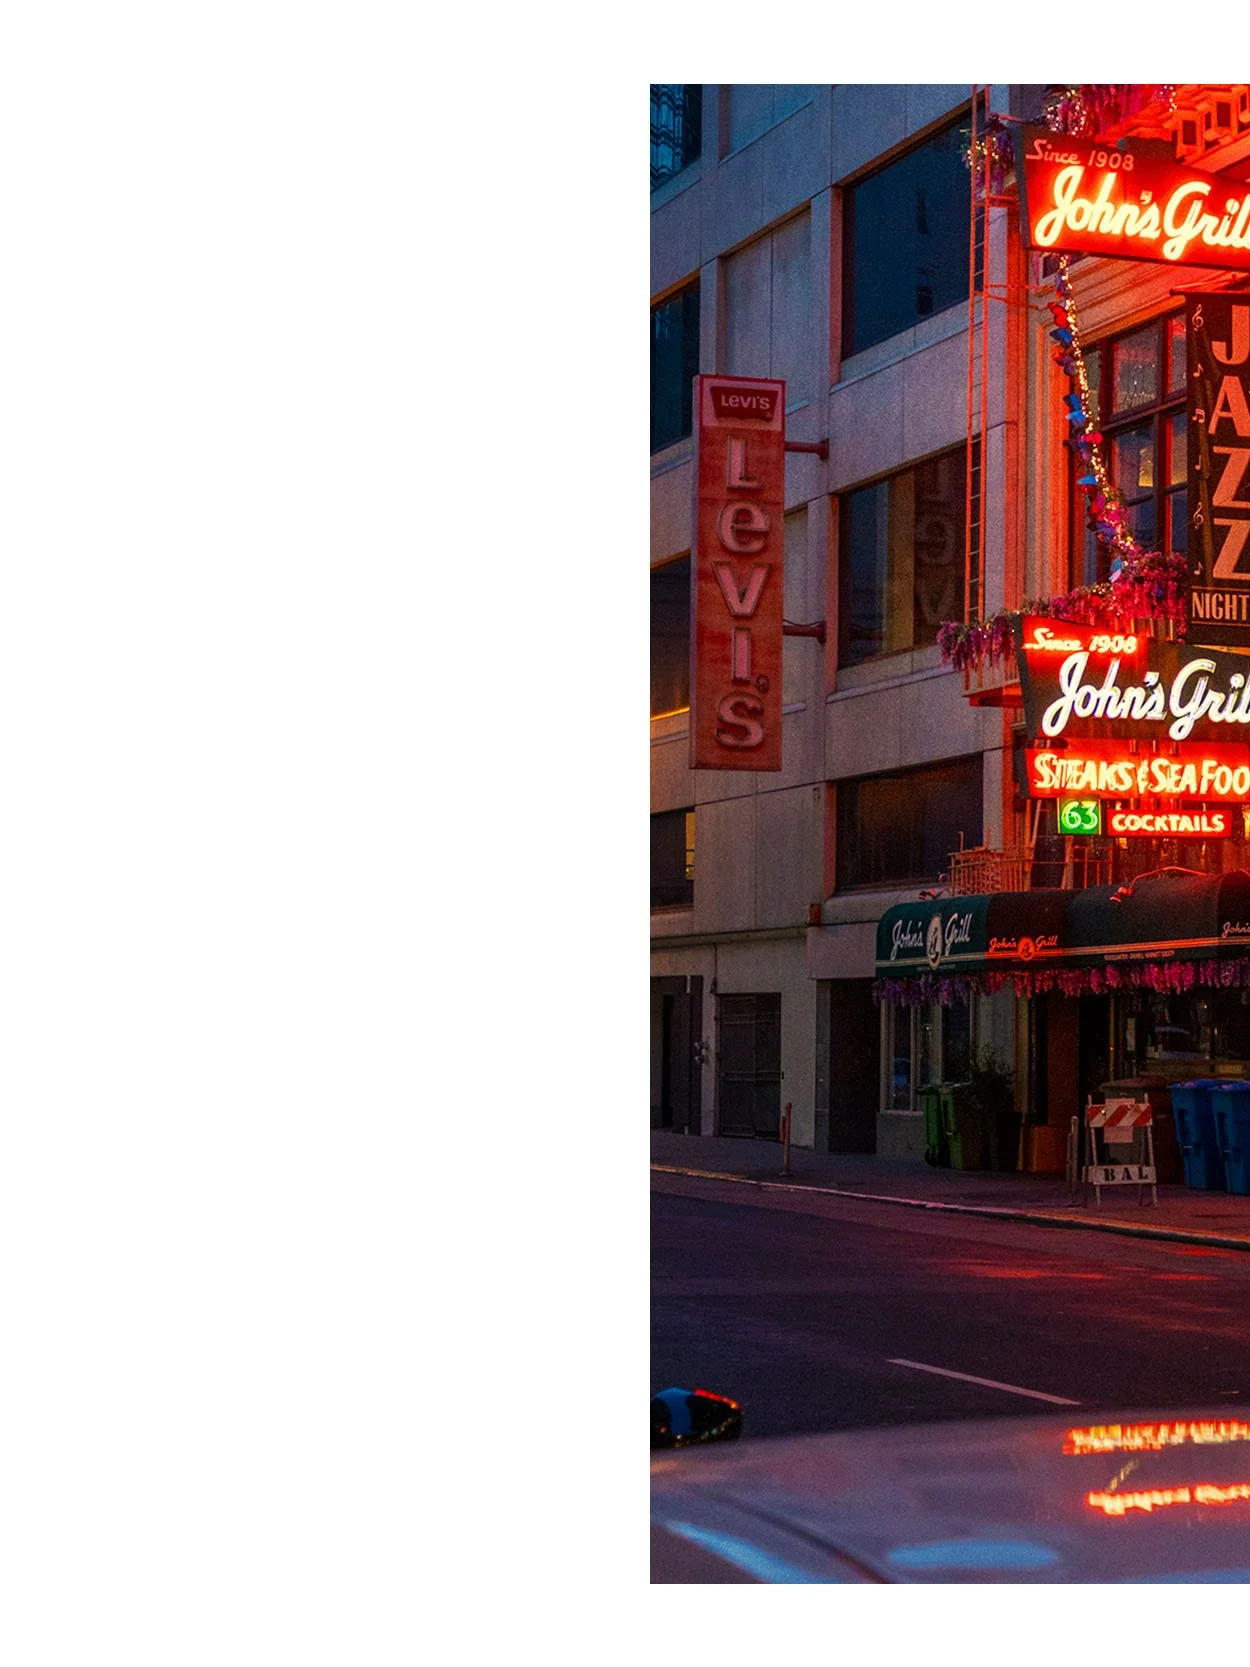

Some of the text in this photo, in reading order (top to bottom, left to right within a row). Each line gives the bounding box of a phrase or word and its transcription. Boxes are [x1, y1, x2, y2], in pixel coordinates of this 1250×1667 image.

[1025, 138, 1134, 171] Since 1908
[1034, 165, 1160, 247] John's
[1024, 628, 1138, 654] Since 1908
[1042, 651, 1166, 736] John's
[1033, 752, 1136, 791] STEAKS
[1060, 800, 1099, 830] 63
[1111, 813, 1225, 833] COCKTAILS
[889, 911, 973, 961] John's Grill
[1034, 934, 1059, 951] Grill
[1103, 1166, 1149, 1182] BAL
